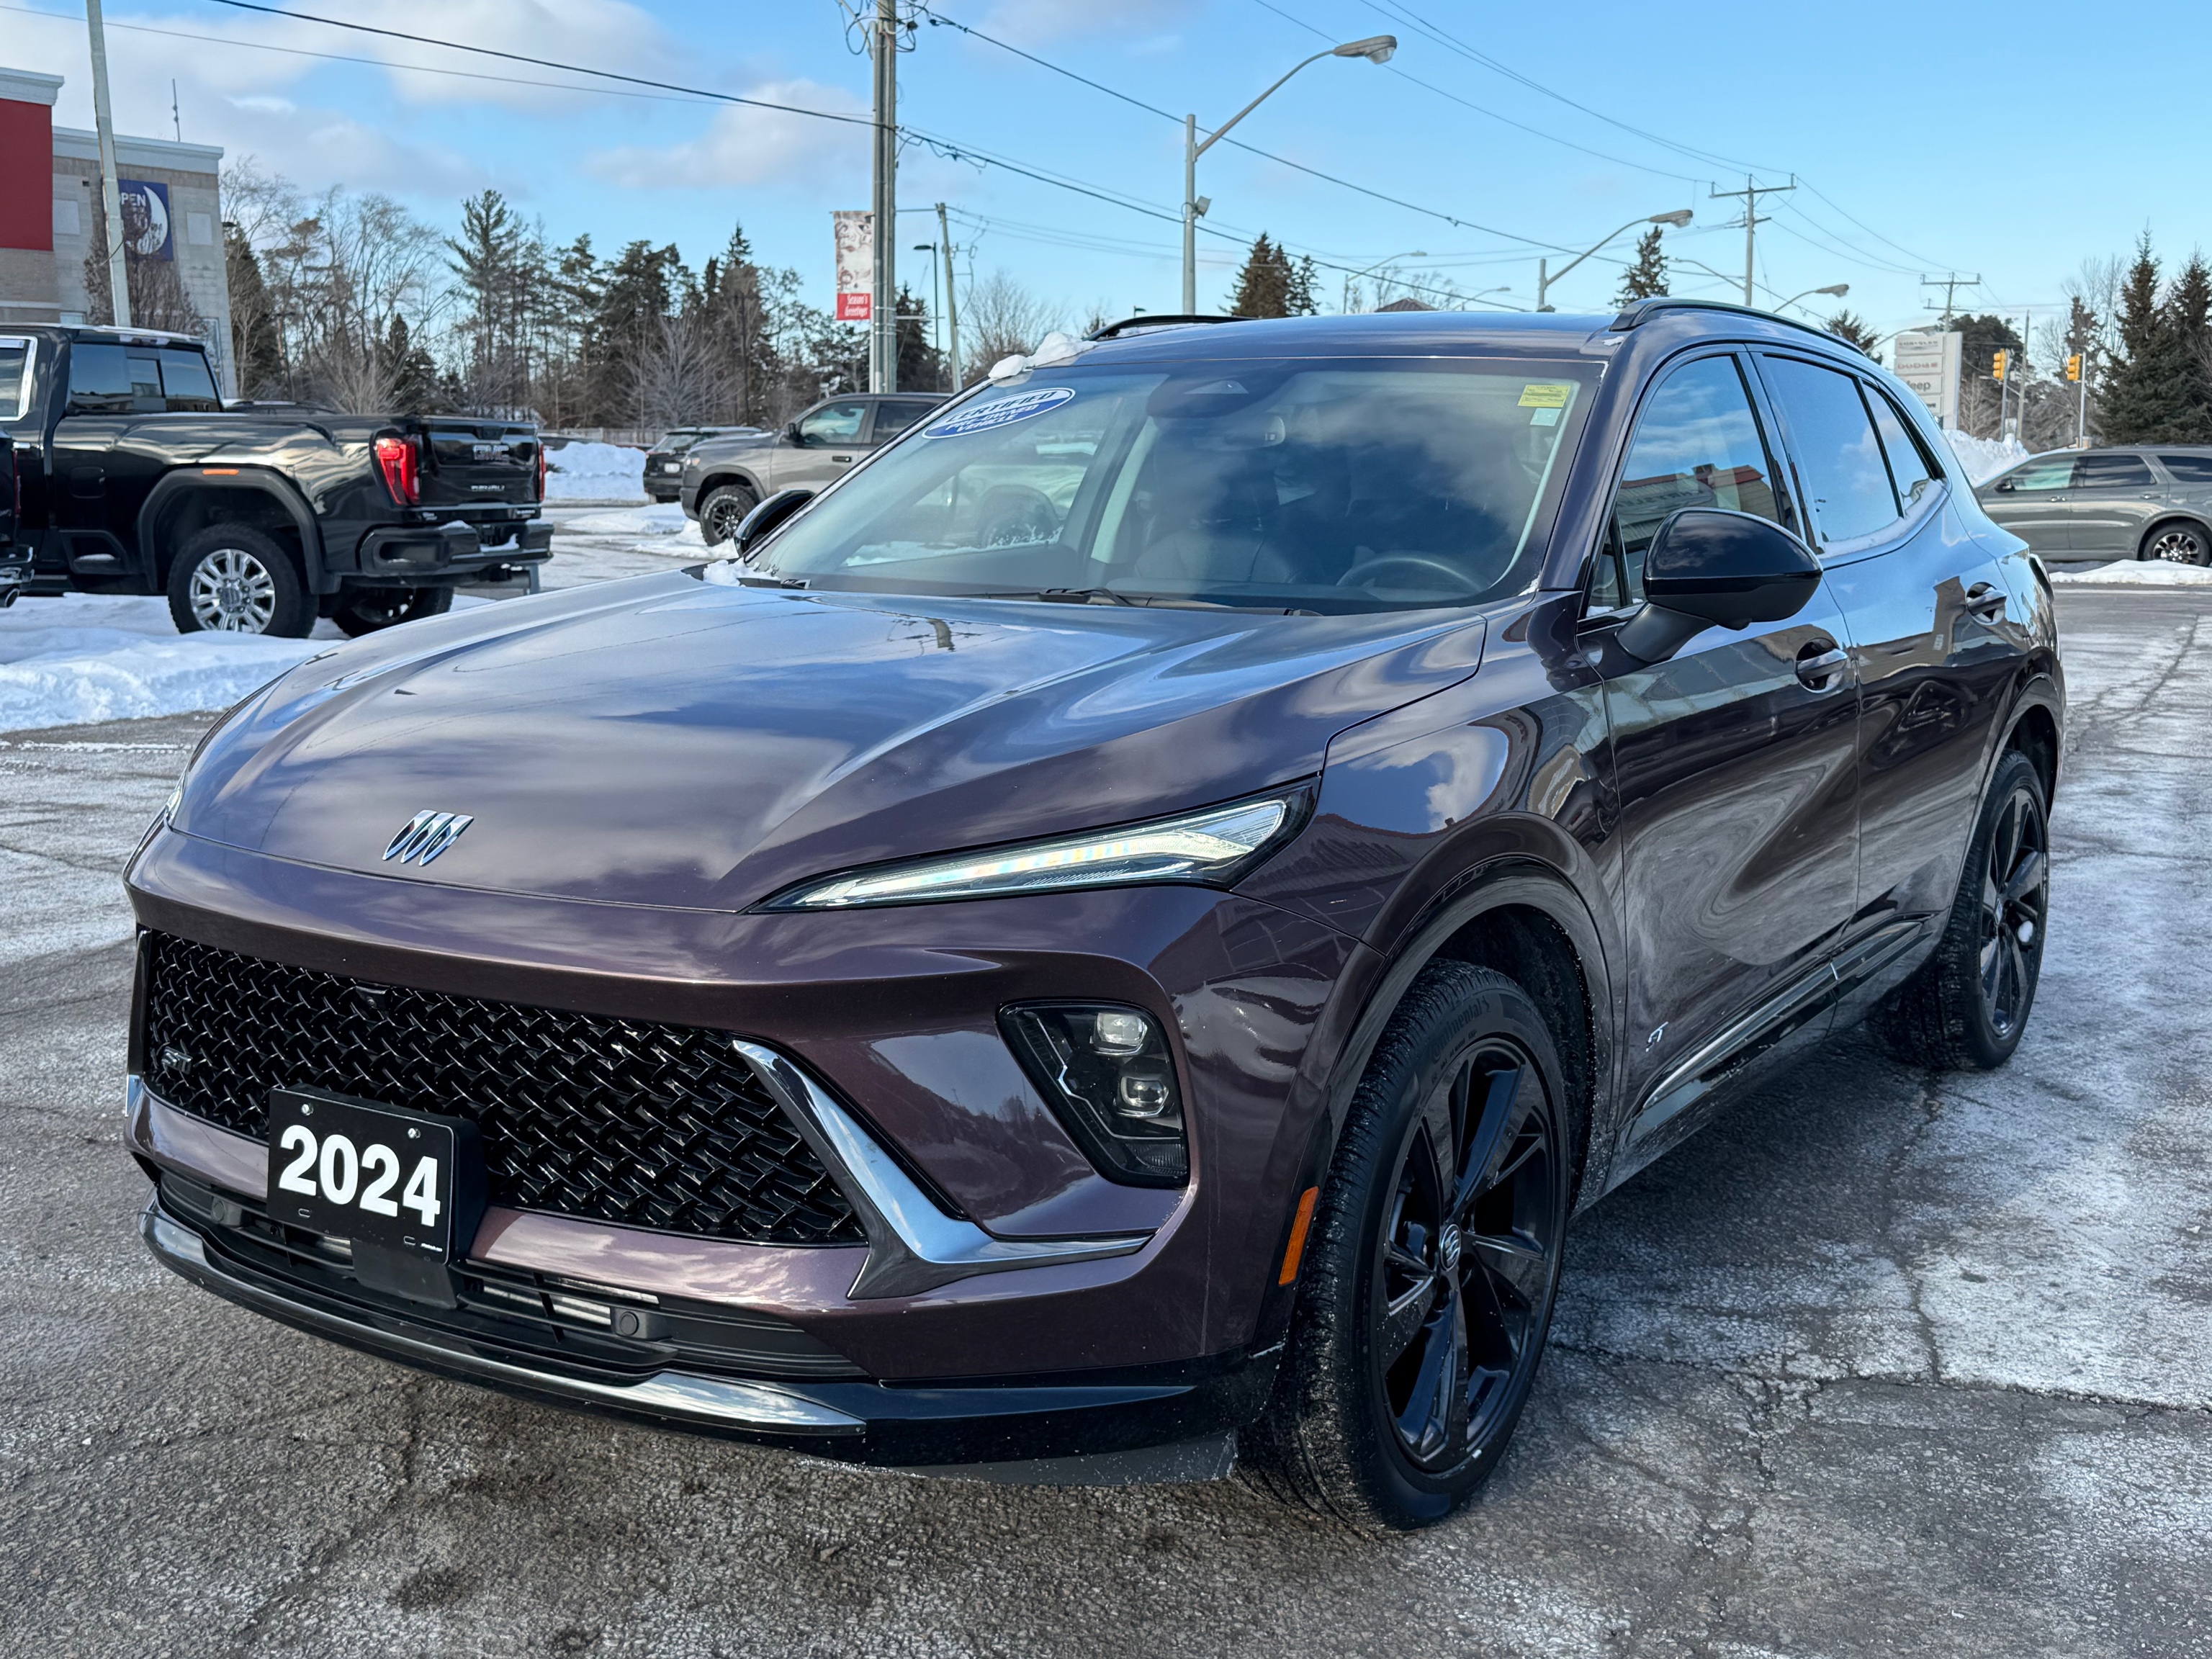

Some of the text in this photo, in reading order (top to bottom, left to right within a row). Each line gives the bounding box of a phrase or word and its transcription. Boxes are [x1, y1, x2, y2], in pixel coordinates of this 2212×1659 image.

[120, 192, 146, 207] PEN
[945, 391, 1058, 423] CERTIFIED
[945, 404, 1039, 431] PRE-OWNED
[956, 413, 1019, 433] VEHICLE
[472, 444, 510, 461] GMC
[279, 1124, 441, 1227] 2024
